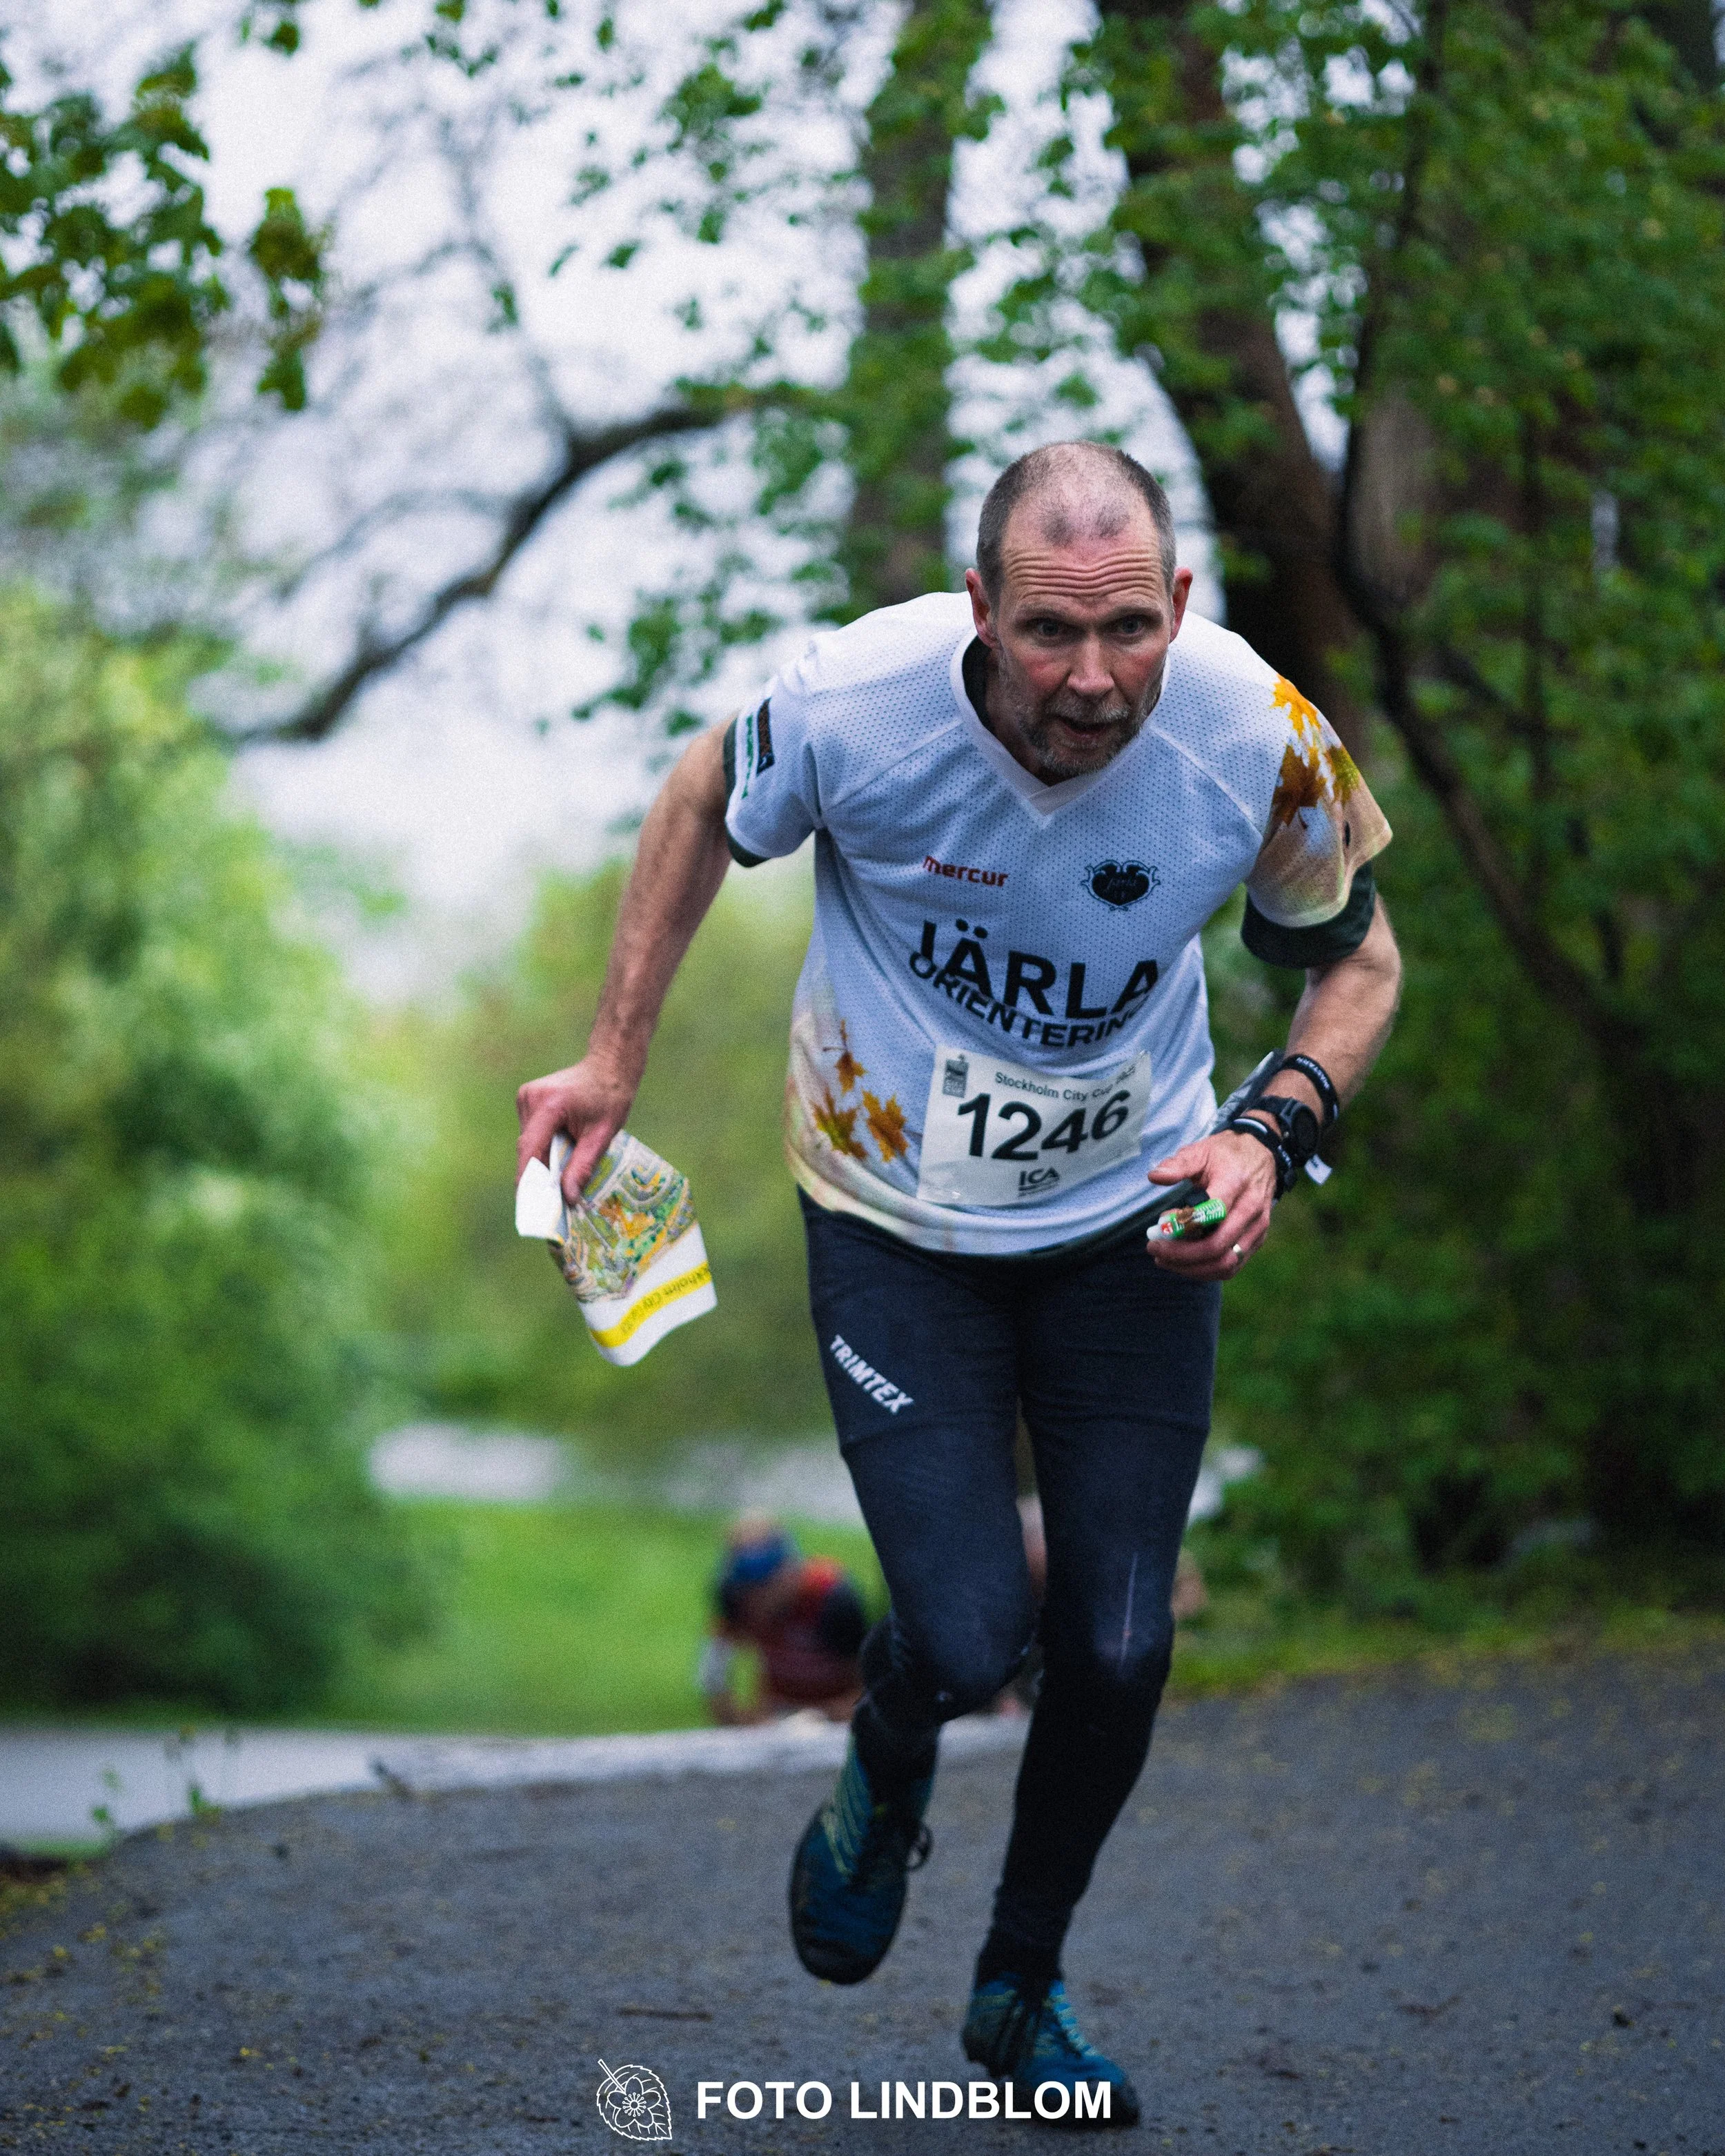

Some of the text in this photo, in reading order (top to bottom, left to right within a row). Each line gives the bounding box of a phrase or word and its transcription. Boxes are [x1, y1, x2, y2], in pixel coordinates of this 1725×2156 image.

[923, 855, 1009, 887] mercur
[995, 1071, 1059, 1099] Stockholm
[1064, 1089, 1088, 1102] City
[958, 1090, 1131, 1160] 1246
[1018, 1167, 1060, 1186] ICA
[830, 1334, 914, 1414] TRIMTEX
